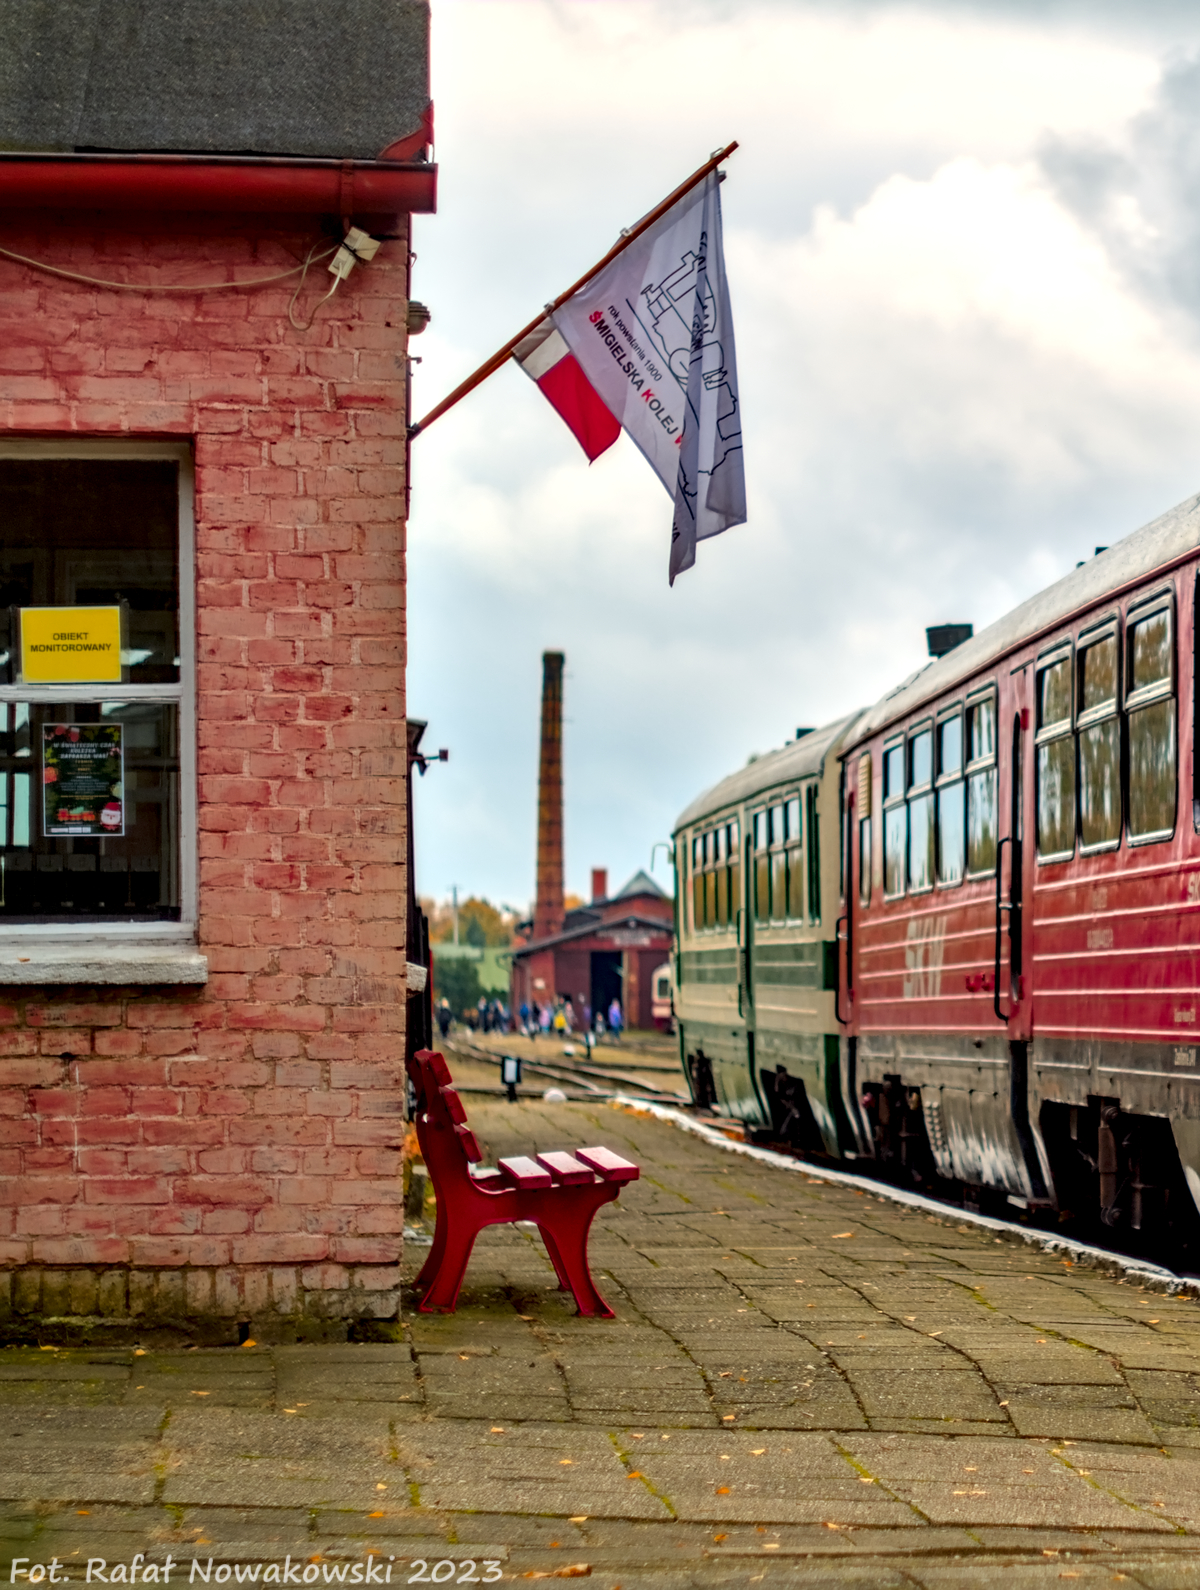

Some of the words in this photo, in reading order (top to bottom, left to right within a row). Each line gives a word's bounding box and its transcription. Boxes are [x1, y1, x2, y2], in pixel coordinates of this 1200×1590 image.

[607, 304, 619, 320] rok
[614, 319, 646, 361] powstania
[643, 359, 663, 382] 1900
[589, 310, 645, 391] ŚMIGIELSKA
[641, 388, 679, 435] KOLEJ
[30, 643, 112, 653] MONITOROWANY
[52, 632, 89, 641] OBIEKT
